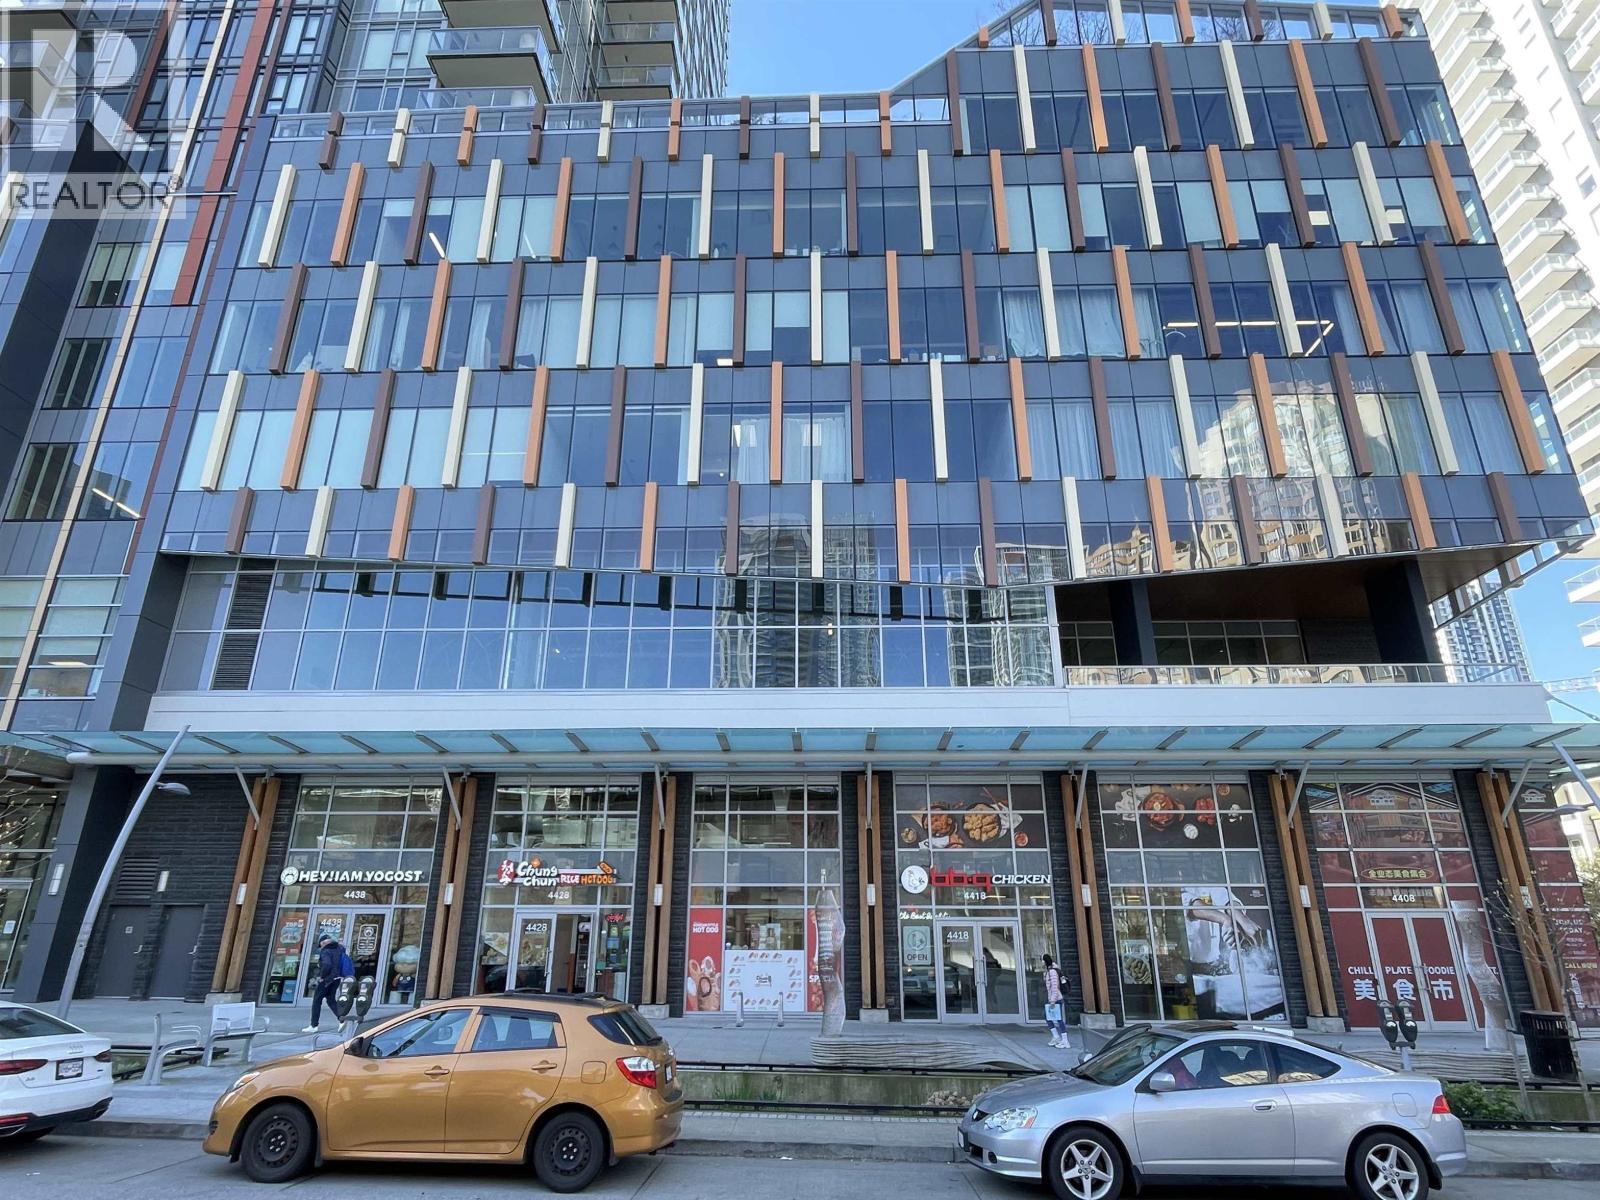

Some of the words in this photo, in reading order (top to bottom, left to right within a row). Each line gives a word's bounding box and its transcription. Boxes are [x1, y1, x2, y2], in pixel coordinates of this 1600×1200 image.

[516, 861, 558, 877] Chung
[365, 870, 423, 882] YOGOST
[561, 874, 580, 884] RICE
[992, 874, 1051, 885] CHICKEN
[344, 890, 366, 899] 4438
[547, 891, 570, 899] 4428
[964, 891, 986, 900] 4418
[1392, 894, 1416, 903] 4408
[320, 918, 342, 927] 4438
[525, 923, 548, 932] 4428
[947, 930, 969, 940] 4418
[906, 953, 928, 961] OPEN
[1385, 966, 1413, 975] PLATE
